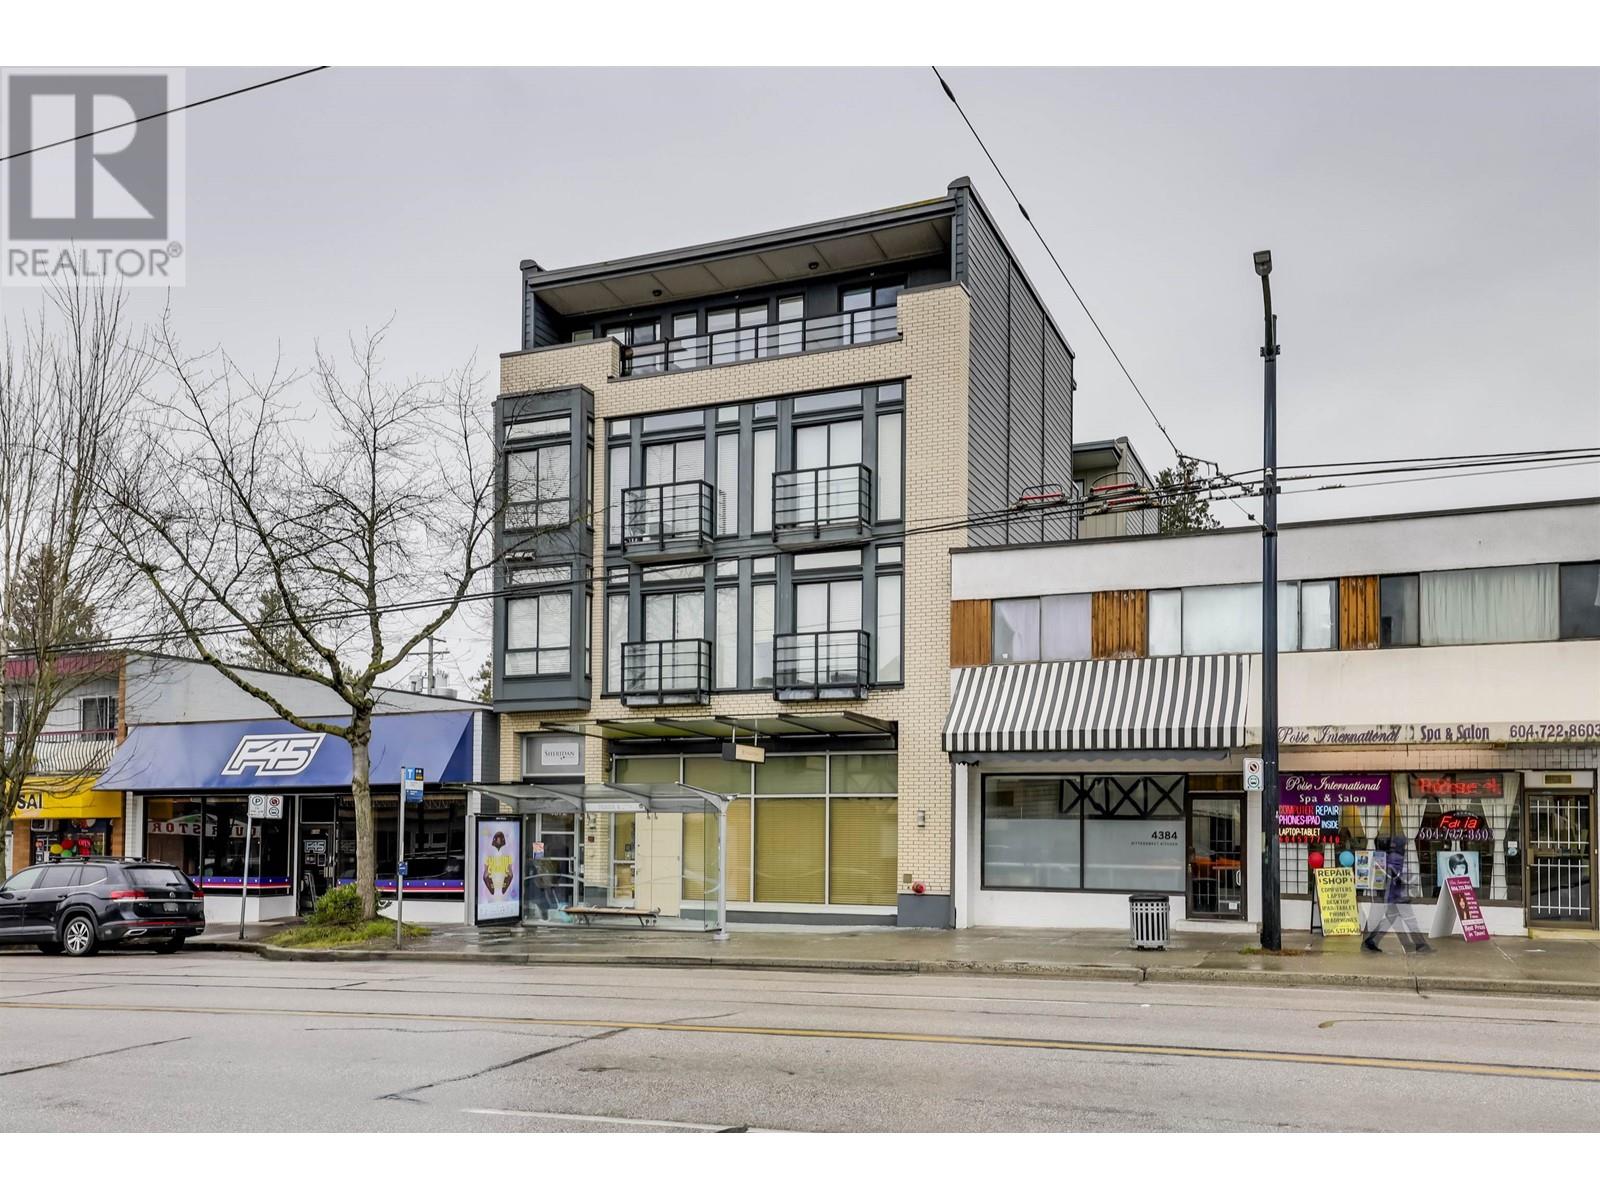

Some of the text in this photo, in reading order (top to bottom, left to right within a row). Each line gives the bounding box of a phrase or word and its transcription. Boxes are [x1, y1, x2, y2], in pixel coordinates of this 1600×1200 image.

[1278, 726, 1310, 743] Poise
[1313, 725, 1401, 744] International
[1420, 726, 1441, 742] Spa
[1445, 727, 1453, 740] &
[1456, 724, 1490, 740] Salon
[222, 734, 325, 775] F45
[1285, 775, 1383, 791] Poise International
[17, 791, 43, 809] SAI
[1299, 794, 1367, 804] Spa & Salon
[1315, 805, 1339, 815] REPAIR
[1321, 820, 1339, 829] INSIDE
[1151, 831, 1177, 840] 4384
[303, 839, 327, 854] F45
[1318, 869, 1351, 877] REPAIR
